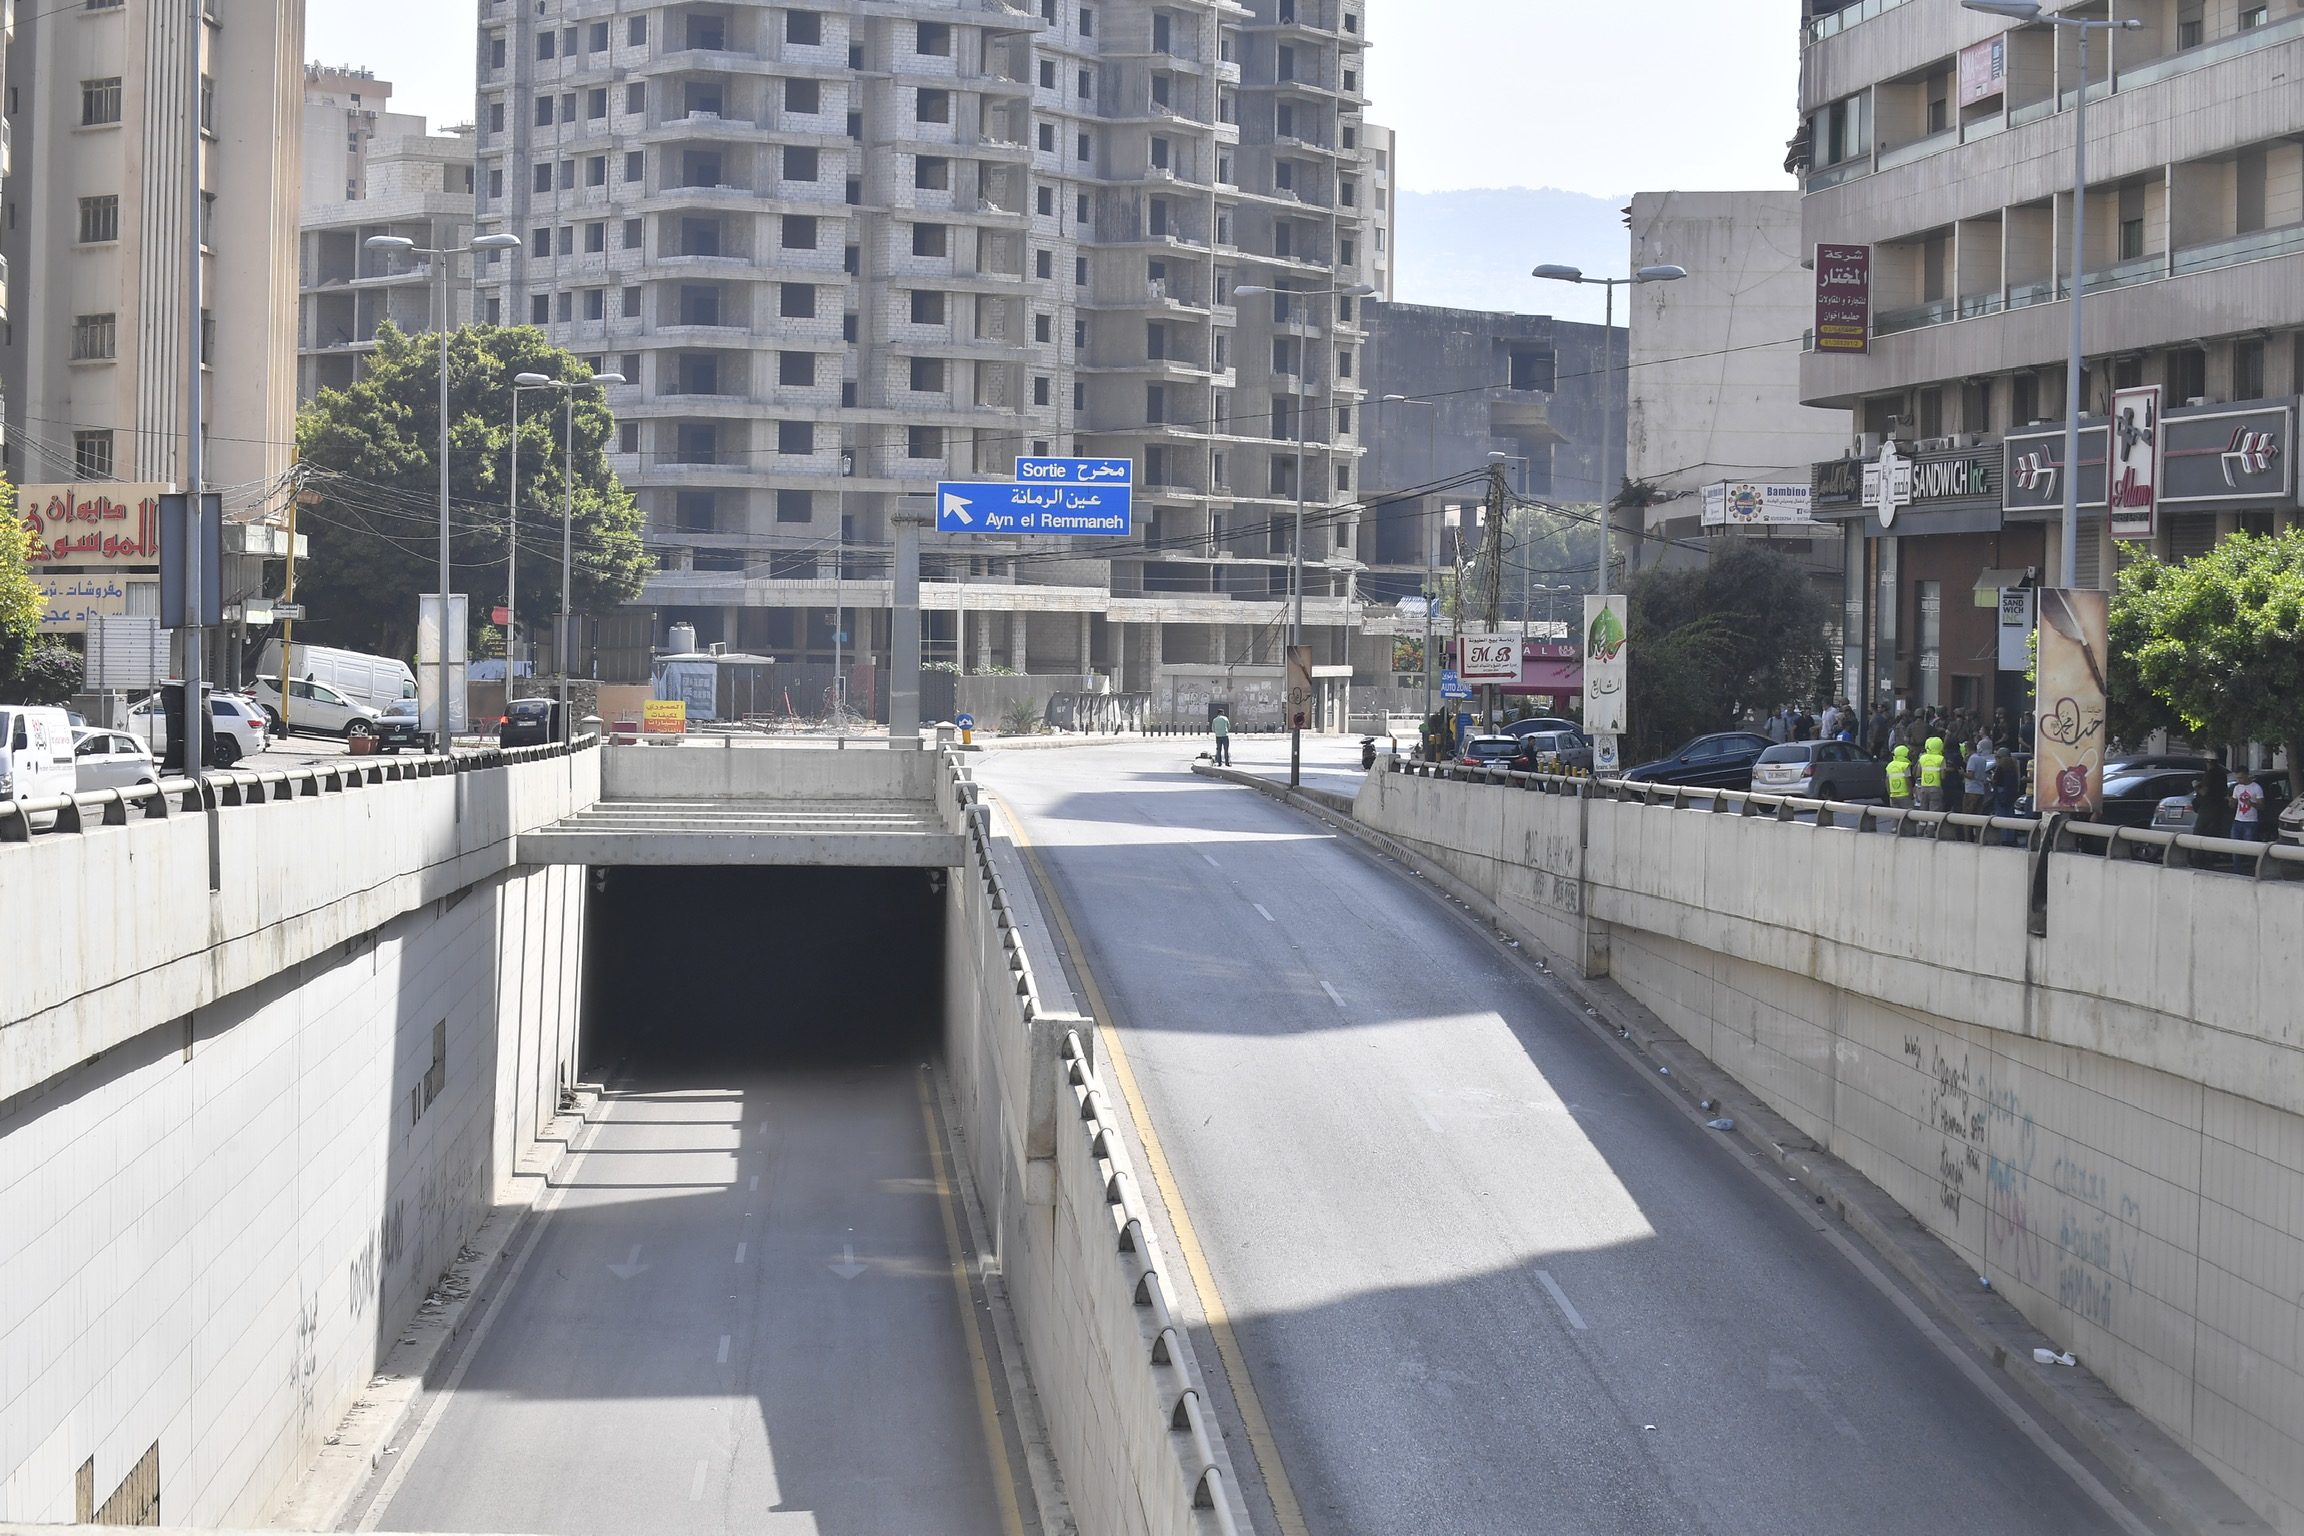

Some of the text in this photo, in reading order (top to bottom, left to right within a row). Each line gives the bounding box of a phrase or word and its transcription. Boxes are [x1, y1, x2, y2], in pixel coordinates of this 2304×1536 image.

[1824, 249, 1863, 262] شركة
[1819, 267, 1868, 287] المختار
[1022, 462, 1066, 478] Sortie
[1913, 460, 1967, 498] SANDWICH
[1969, 459, 1987, 494] Inc.
[1011, 488, 1101, 510] عين الرمانة
[1766, 486, 1807, 497] Bambino
[985, 512, 1124, 530] Ayn el Remmaneh
[66, 580, 123, 599] مفروشات
[2003, 599, 2024, 607] SAND
[2003, 606, 2024, 614] WICH
[1441, 683, 1472, 692] AUTO ZONE
